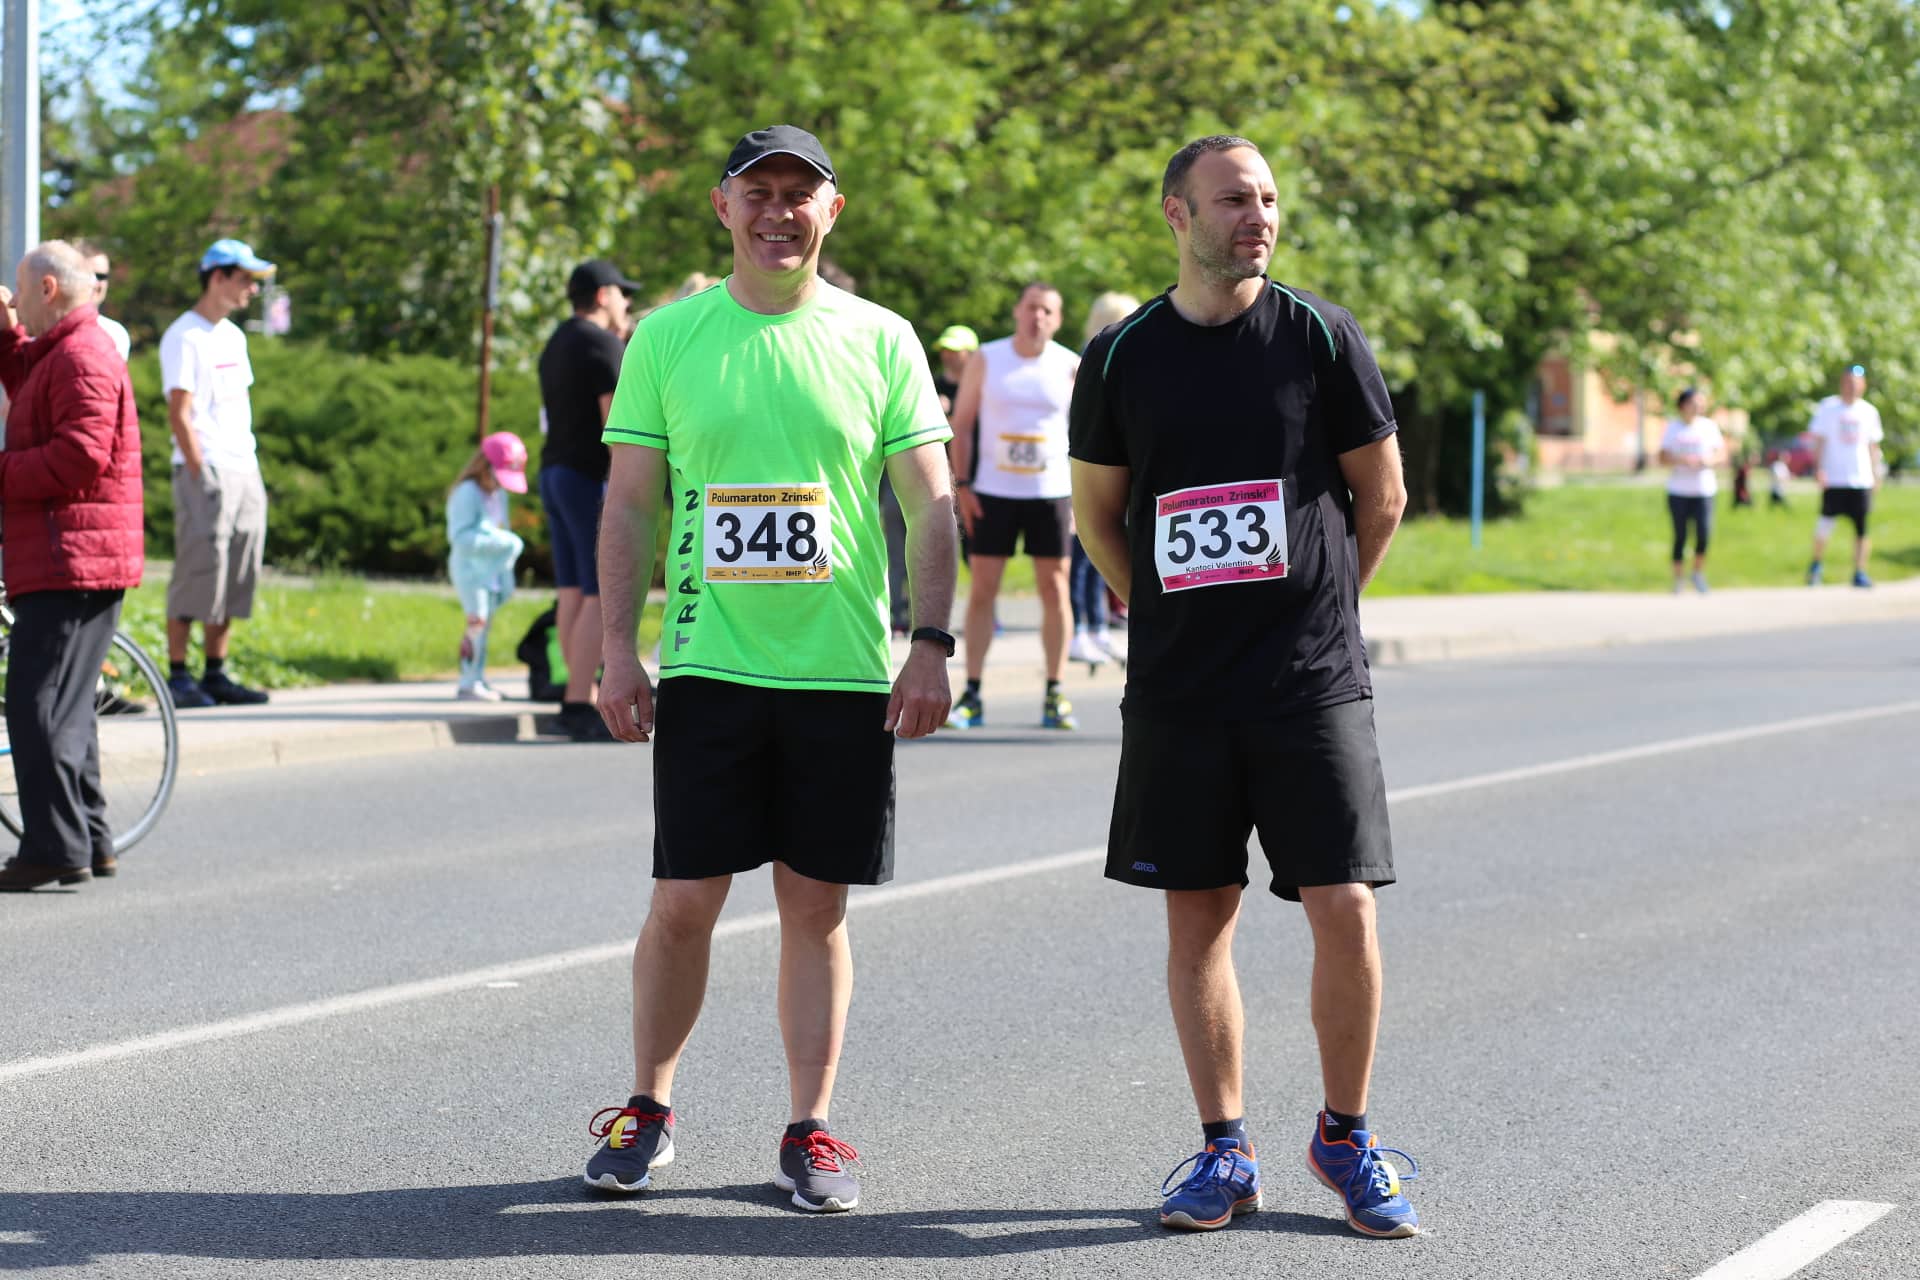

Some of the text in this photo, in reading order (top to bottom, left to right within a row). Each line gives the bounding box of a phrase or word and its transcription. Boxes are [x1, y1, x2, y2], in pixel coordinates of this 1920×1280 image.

[711, 491, 818, 503] Polumaraton Zrinski
[1162, 494, 1224, 512] Polumaraton
[715, 512, 818, 563] 348
[1167, 505, 1270, 564] 533
[1215, 559, 1253, 569] Valentino
